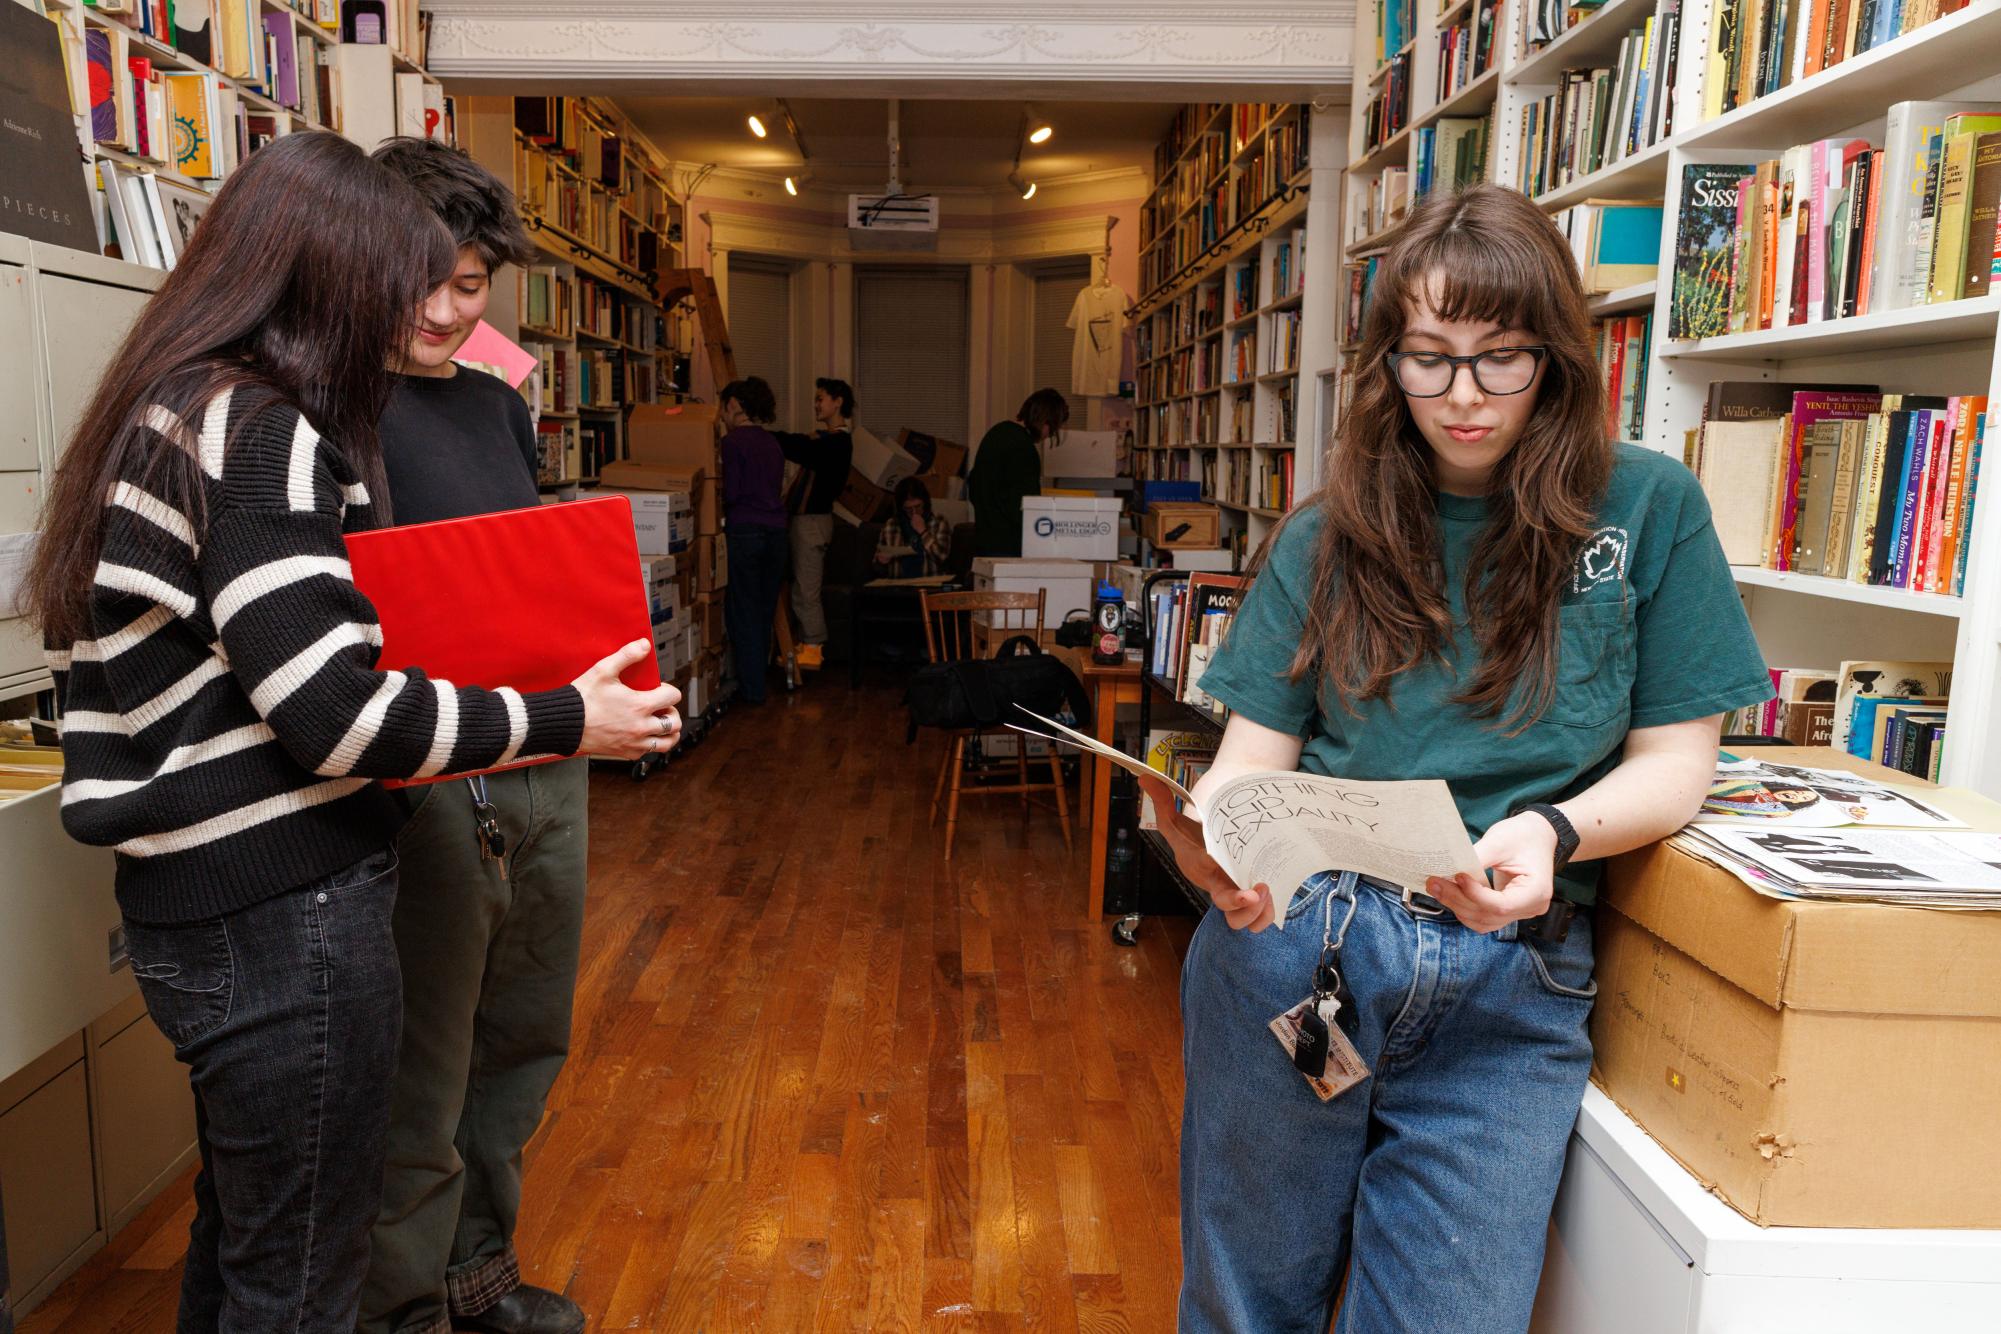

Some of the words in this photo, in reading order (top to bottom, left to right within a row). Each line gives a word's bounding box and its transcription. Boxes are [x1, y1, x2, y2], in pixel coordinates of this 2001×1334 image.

[1811, 163, 1820, 208] BEHIND
[3, 195, 72, 226] PIECES
[1762, 203, 1775, 215] 34
[1854, 201, 1863, 229] Anarchist
[1733, 224, 1743, 254] SUSAN
[1809, 239, 1817, 269] MASK
[1722, 405, 1749, 417] Willa
[1806, 402, 1831, 410] YENTL
[1832, 402, 1849, 410] THE
[1851, 403, 1880, 411] YESHIV
[1955, 400, 1969, 436] ZORA
[1915, 418, 1928, 445] ZACH
[1868, 441, 1882, 494] CONQUEST
[1911, 447, 1923, 481] WAHLS
[1951, 440, 1964, 479] NEALE
[1904, 490, 1916, 508] My
[1942, 482, 1959, 538] HURSTON
[1902, 510, 1913, 532] Two
[1897, 533, 1909, 564] Moms
[1814, 715, 1834, 726] The
[1211, 782, 1380, 844] CLOTHING
[1223, 796, 1285, 855] AND
[1231, 806, 1379, 865] SEXUALITY
